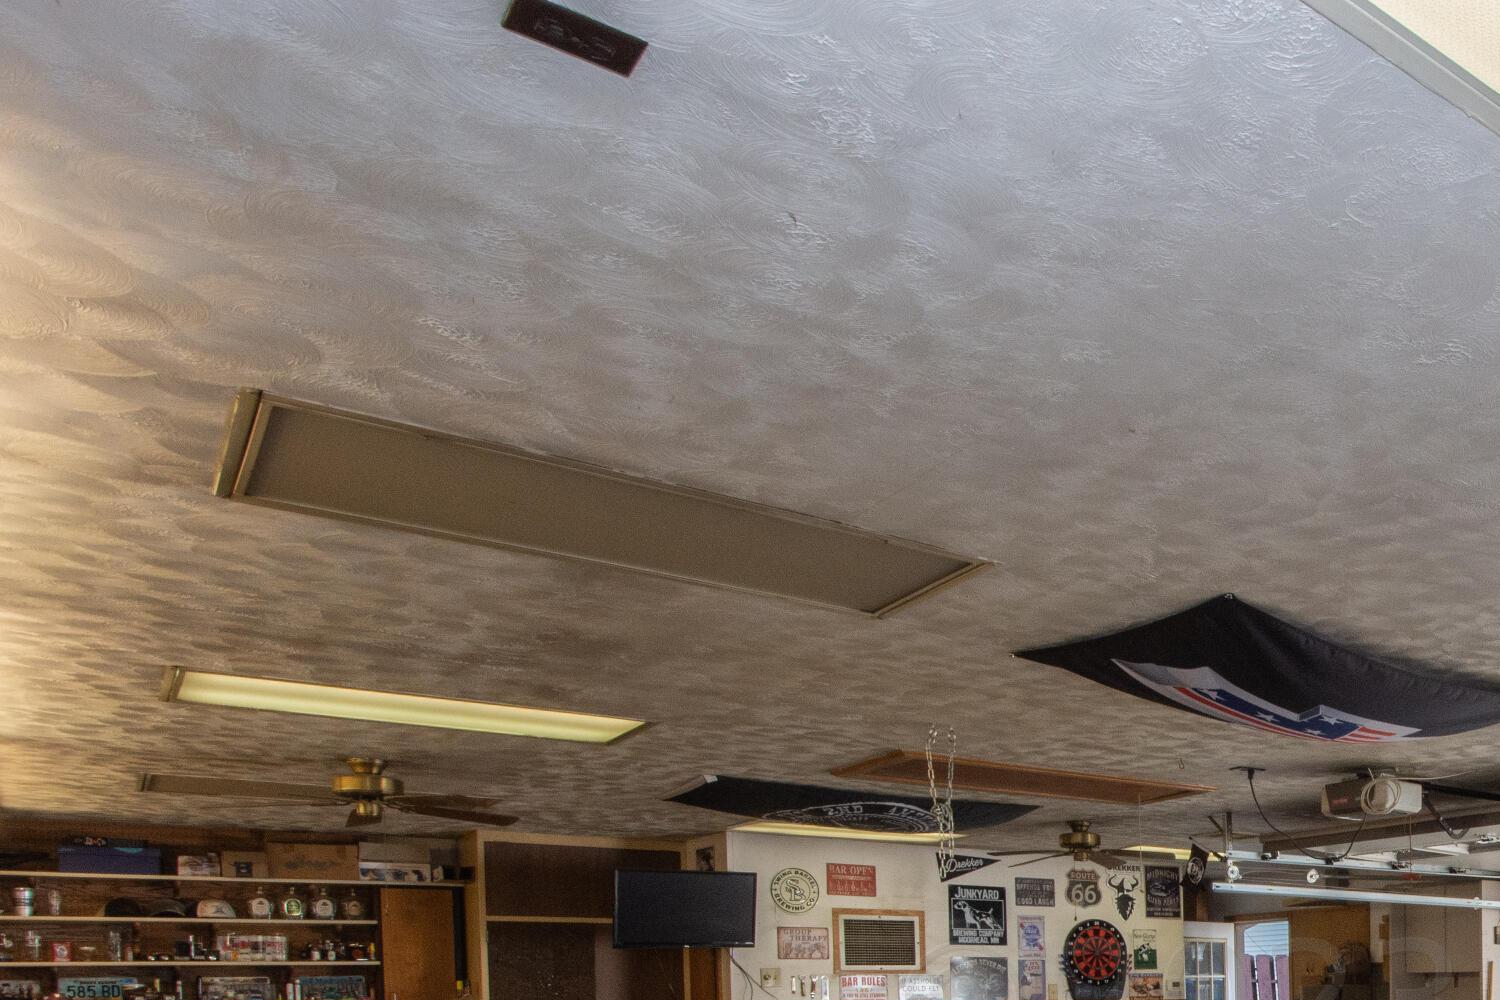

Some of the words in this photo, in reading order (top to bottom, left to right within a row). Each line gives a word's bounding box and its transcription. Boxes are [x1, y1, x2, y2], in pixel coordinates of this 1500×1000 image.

[946, 858, 984, 872] Drekker
[1070, 872, 1097, 880] ROUTE
[954, 886, 1000, 900] JUNKYARD
[1071, 884, 1097, 903] 66
[774, 892, 805, 911] BREWING
[841, 977, 858, 987] BAR
[861, 976, 886, 987] RULES
[67, 985, 96, 999] 585
[101, 984, 121, 998] BD
